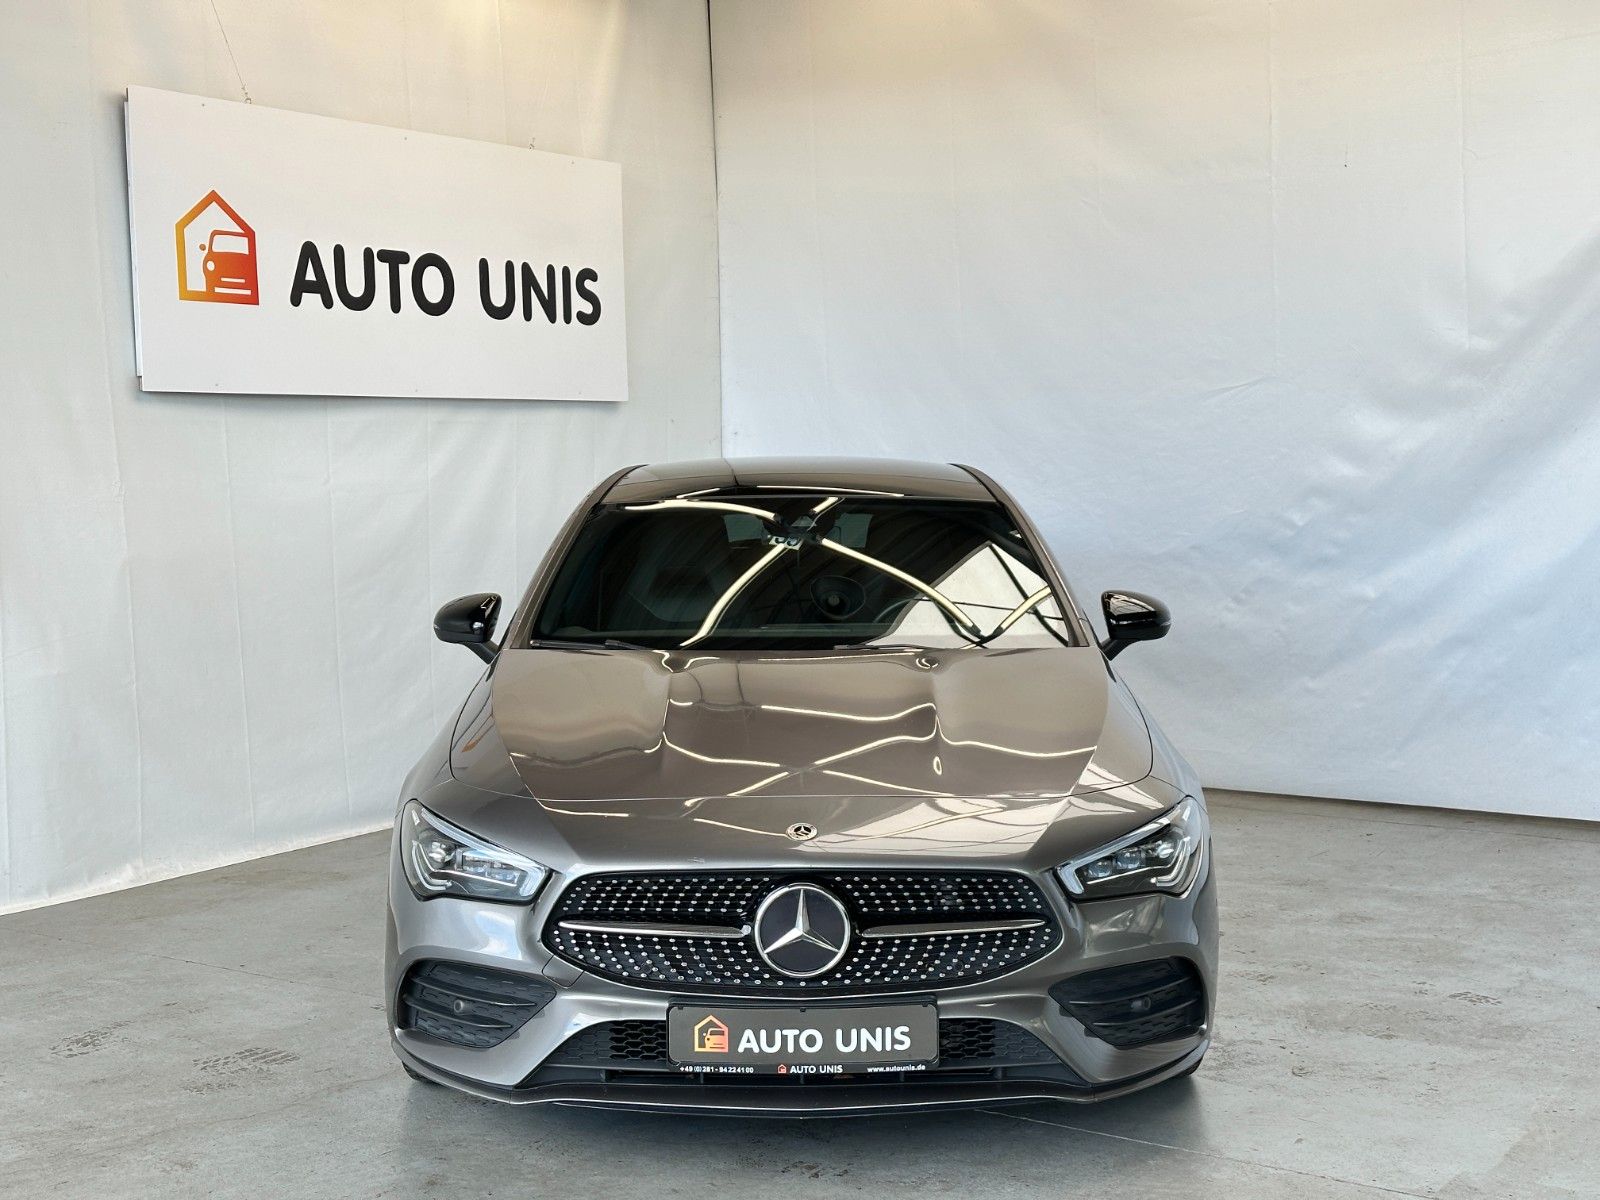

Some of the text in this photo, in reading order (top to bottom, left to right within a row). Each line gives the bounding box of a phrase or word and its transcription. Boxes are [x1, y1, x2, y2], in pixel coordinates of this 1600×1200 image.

[289, 240, 601, 326] AUTO UNIS
[737, 1025, 912, 1054] AUTO UNIS
[789, 1065, 844, 1074] AUTO UNIS
[867, 1064, 926, 1073] www.autounis.de
